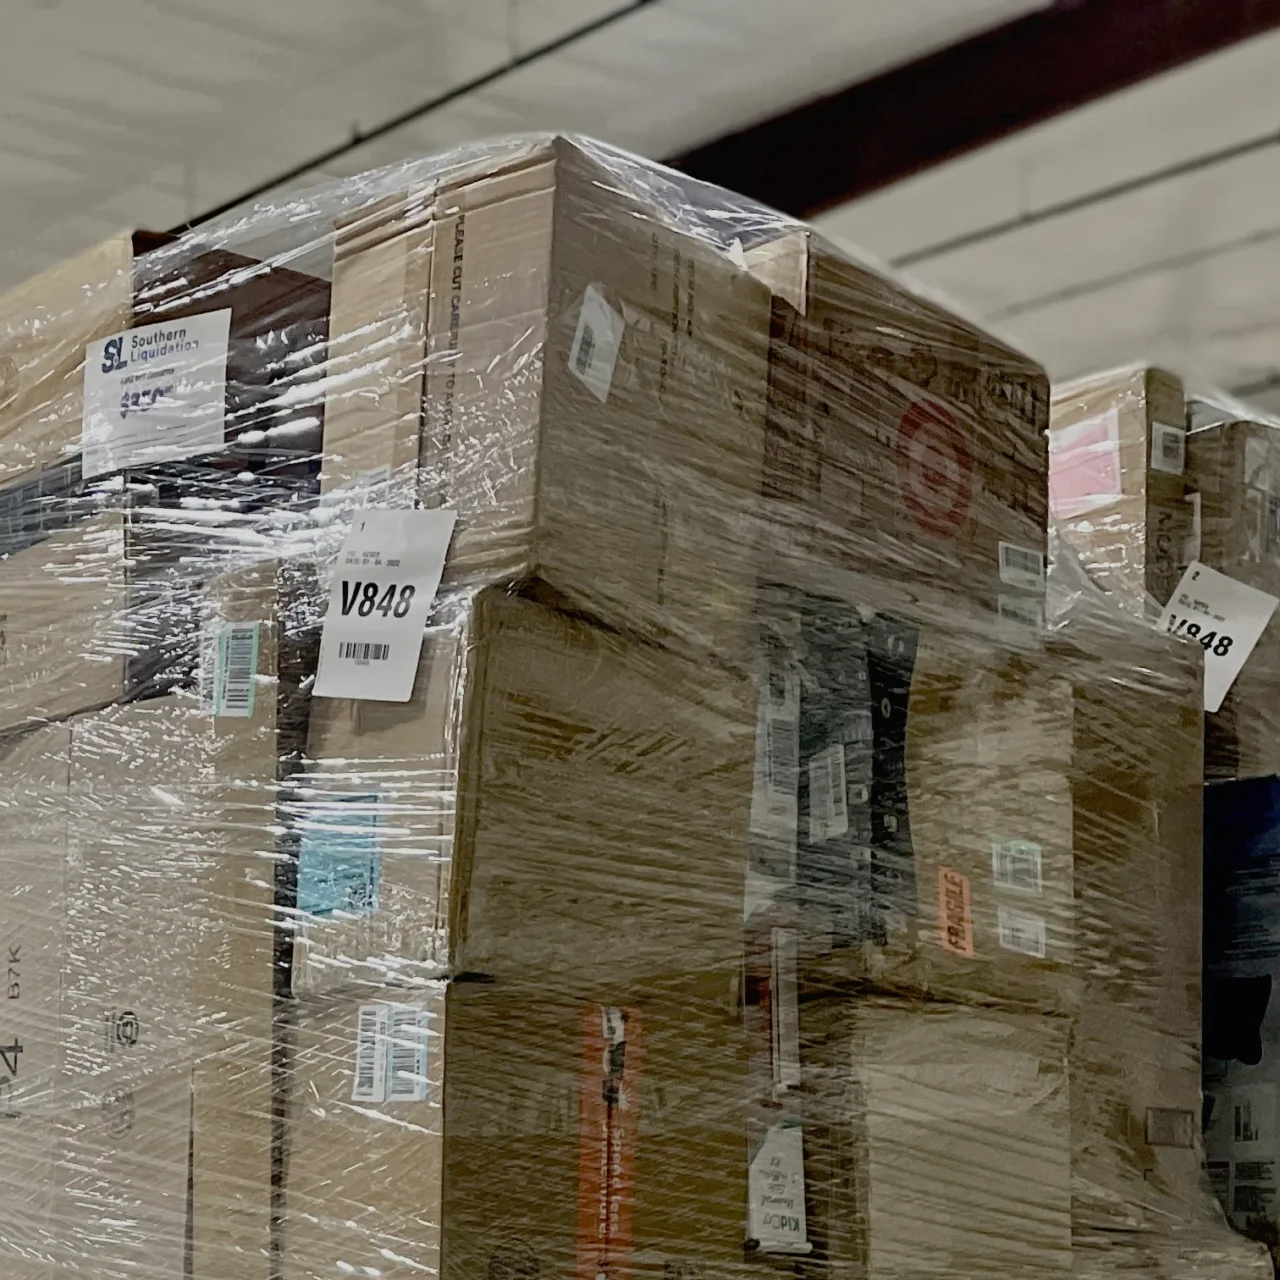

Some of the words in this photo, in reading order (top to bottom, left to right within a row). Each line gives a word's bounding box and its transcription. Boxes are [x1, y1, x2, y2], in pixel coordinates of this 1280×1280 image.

[452, 214, 465, 262] PLEASE
[451, 266, 463, 291] CUT
[131, 328, 187, 349] Southern
[446, 295, 461, 368] CAREFULY
[101, 336, 128, 374] SL
[130, 339, 200, 363] Liquidation
[445, 373, 456, 389] TO
[341, 580, 416, 619] V848
[943, 872, 967, 952] FRAGILE
